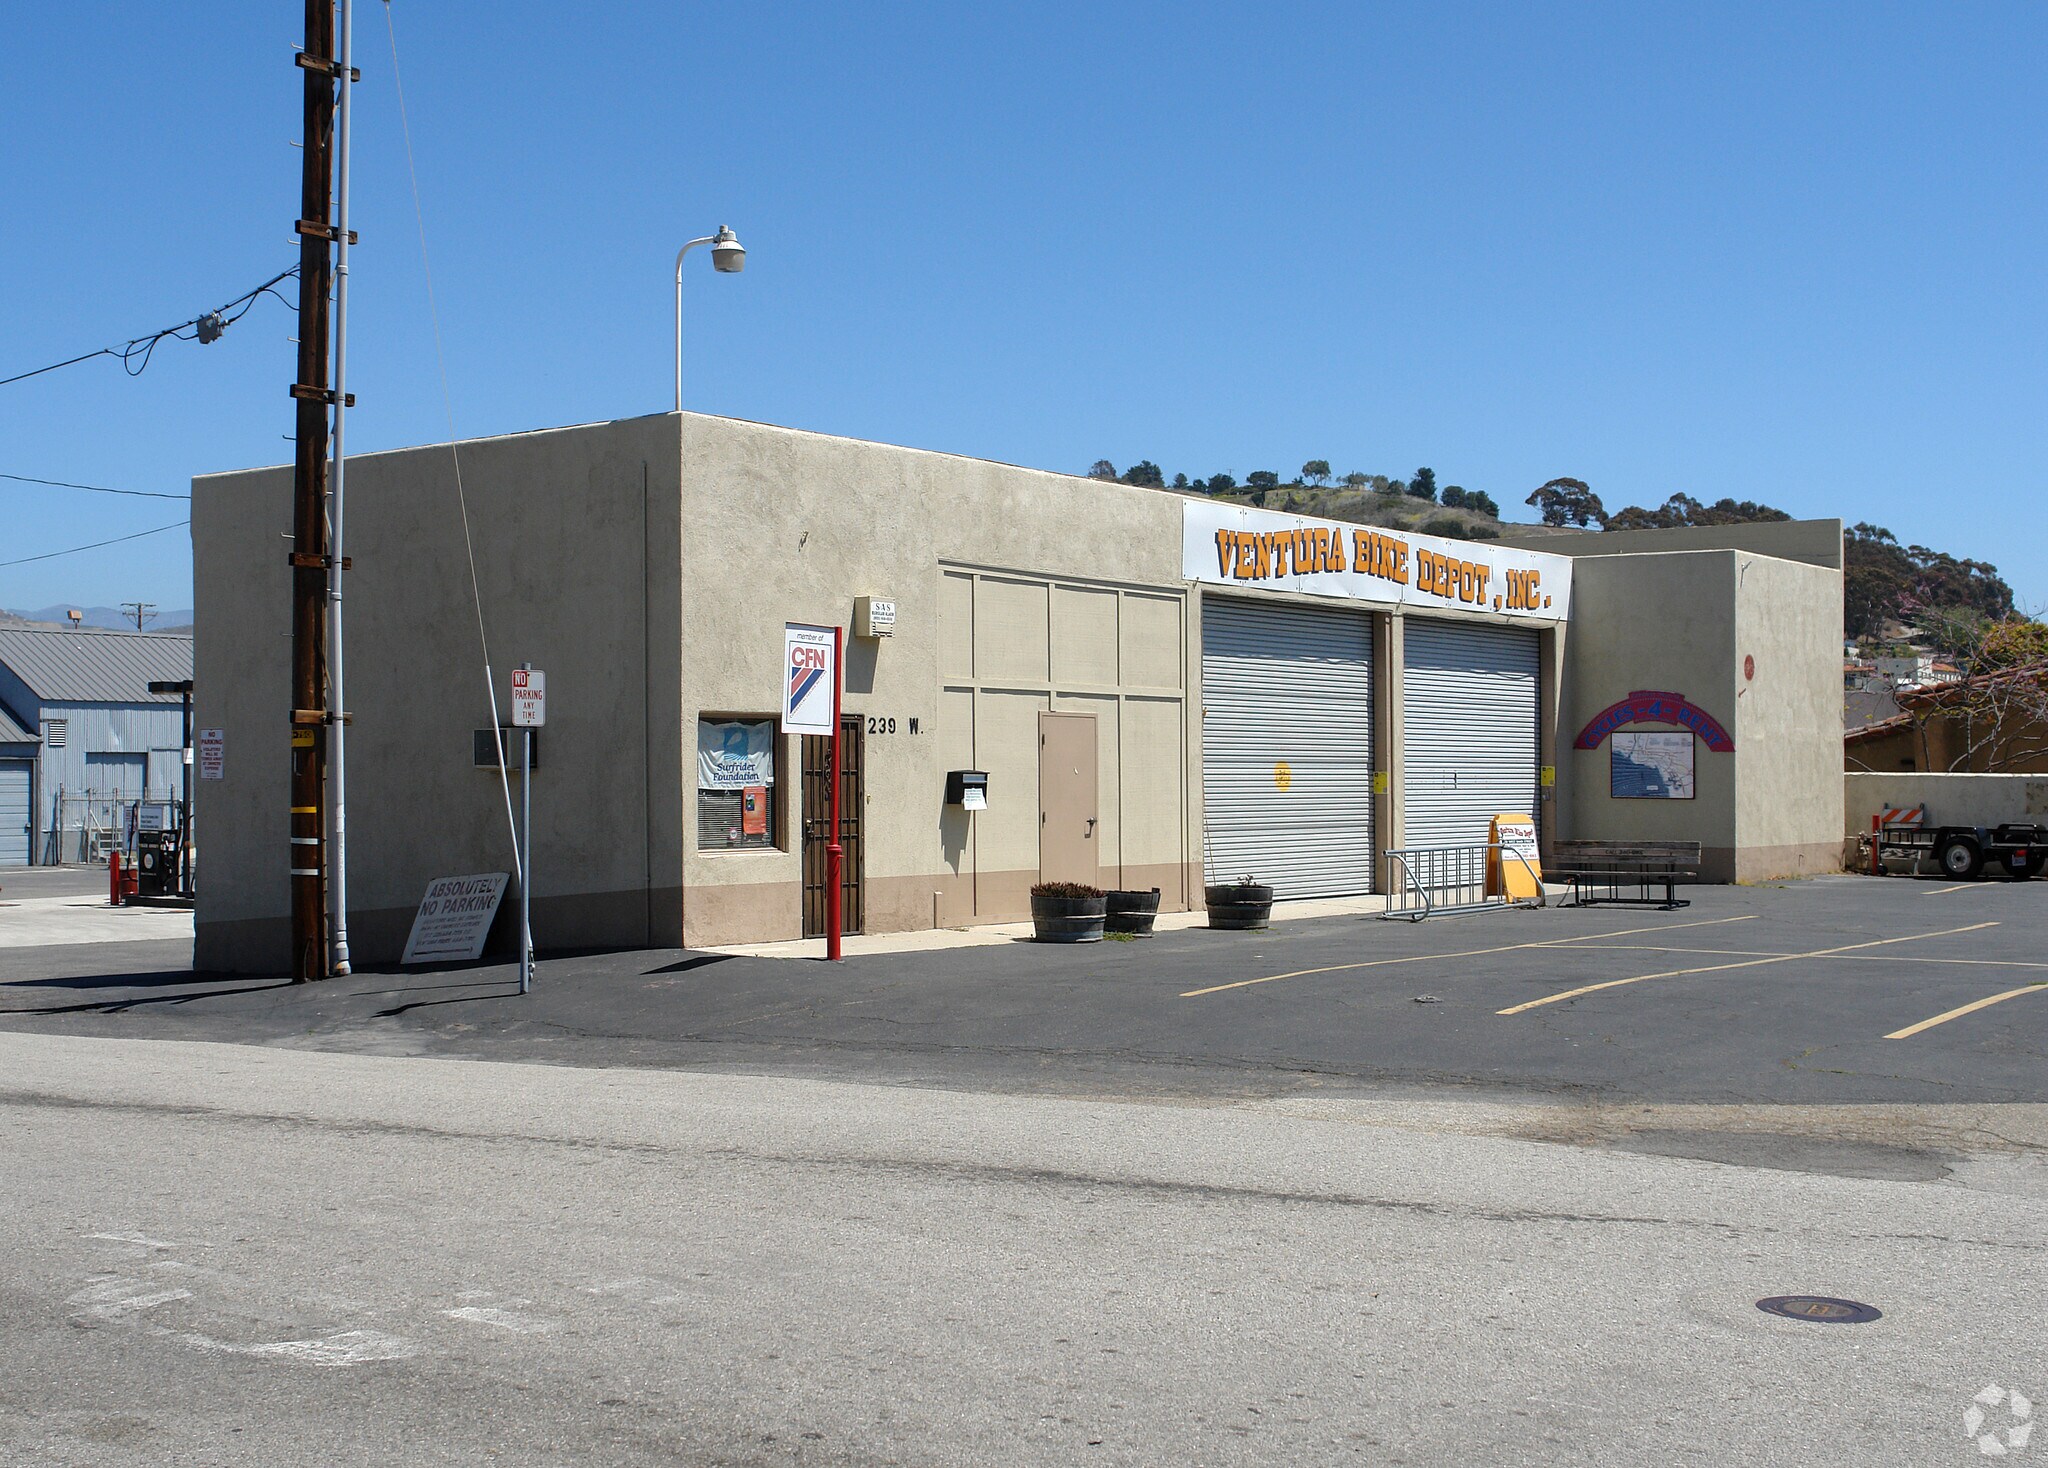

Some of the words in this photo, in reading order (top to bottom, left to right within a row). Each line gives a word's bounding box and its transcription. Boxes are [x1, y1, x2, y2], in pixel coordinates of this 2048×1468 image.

[1215, 527, 1347, 580] VENTURA
[1352, 529, 1409, 584] BIKE
[1505, 568, 1552, 610] INC.
[797, 633, 818, 641] member
[791, 646, 825, 668] CFN
[514, 672, 526, 686] NO
[515, 689, 543, 700] PARKING
[523, 702, 534, 710] ANY
[522, 711, 536, 719] TIME
[868, 717, 896, 734] 239
[909, 717, 924, 735] W.
[1585, 705, 1635, 747] CYCLES
[1678, 708, 1724, 746] RENT
[717, 762, 756, 773] Surfrider
[713, 772, 760, 781] Foundation
[428, 879, 502, 898] ABSOLUTELY
[420, 901, 438, 916] NO
[441, 895, 496, 914] PARKING
